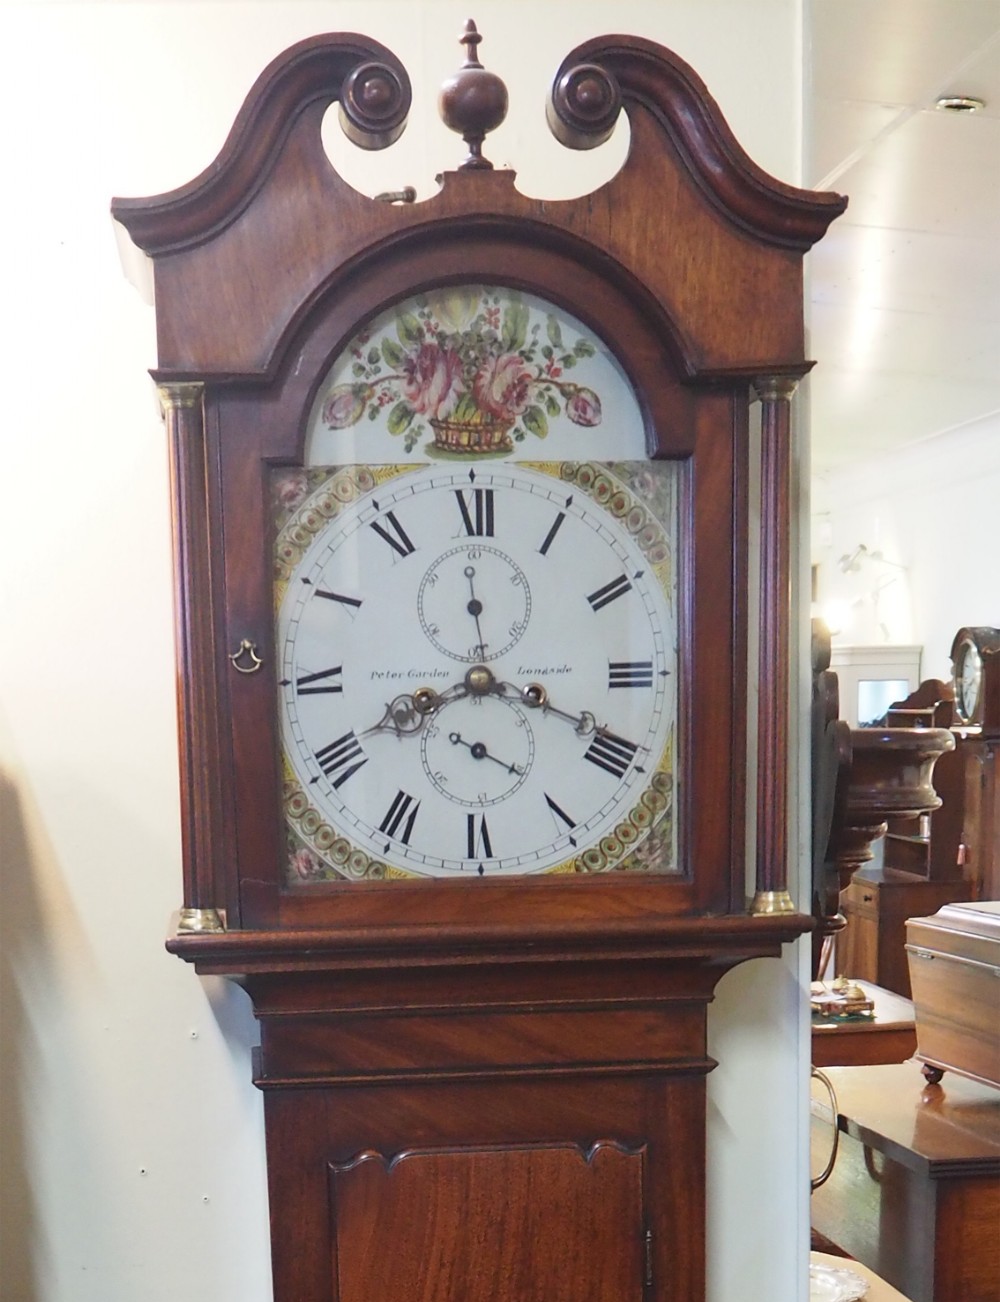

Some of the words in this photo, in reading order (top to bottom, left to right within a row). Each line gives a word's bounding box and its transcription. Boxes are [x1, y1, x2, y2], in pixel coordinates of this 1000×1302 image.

[451, 488, 497, 538] XII
[368, 510, 418, 566] XI
[535, 511, 569, 557] I
[467, 549, 482, 561] 60
[312, 579, 363, 621] X
[427, 573, 439, 588] 50
[510, 574, 522, 587] 10
[584, 574, 635, 613] II
[508, 620, 522, 638] 20
[296, 664, 344, 697] IX
[370, 669, 403, 680] Peter
[407, 668, 449, 679] Garden
[608, 660, 654, 689] III
[312, 729, 369, 790] VIII
[375, 788, 422, 847] VII
[543, 792, 581, 836] V
[464, 811, 497, 860] VI
